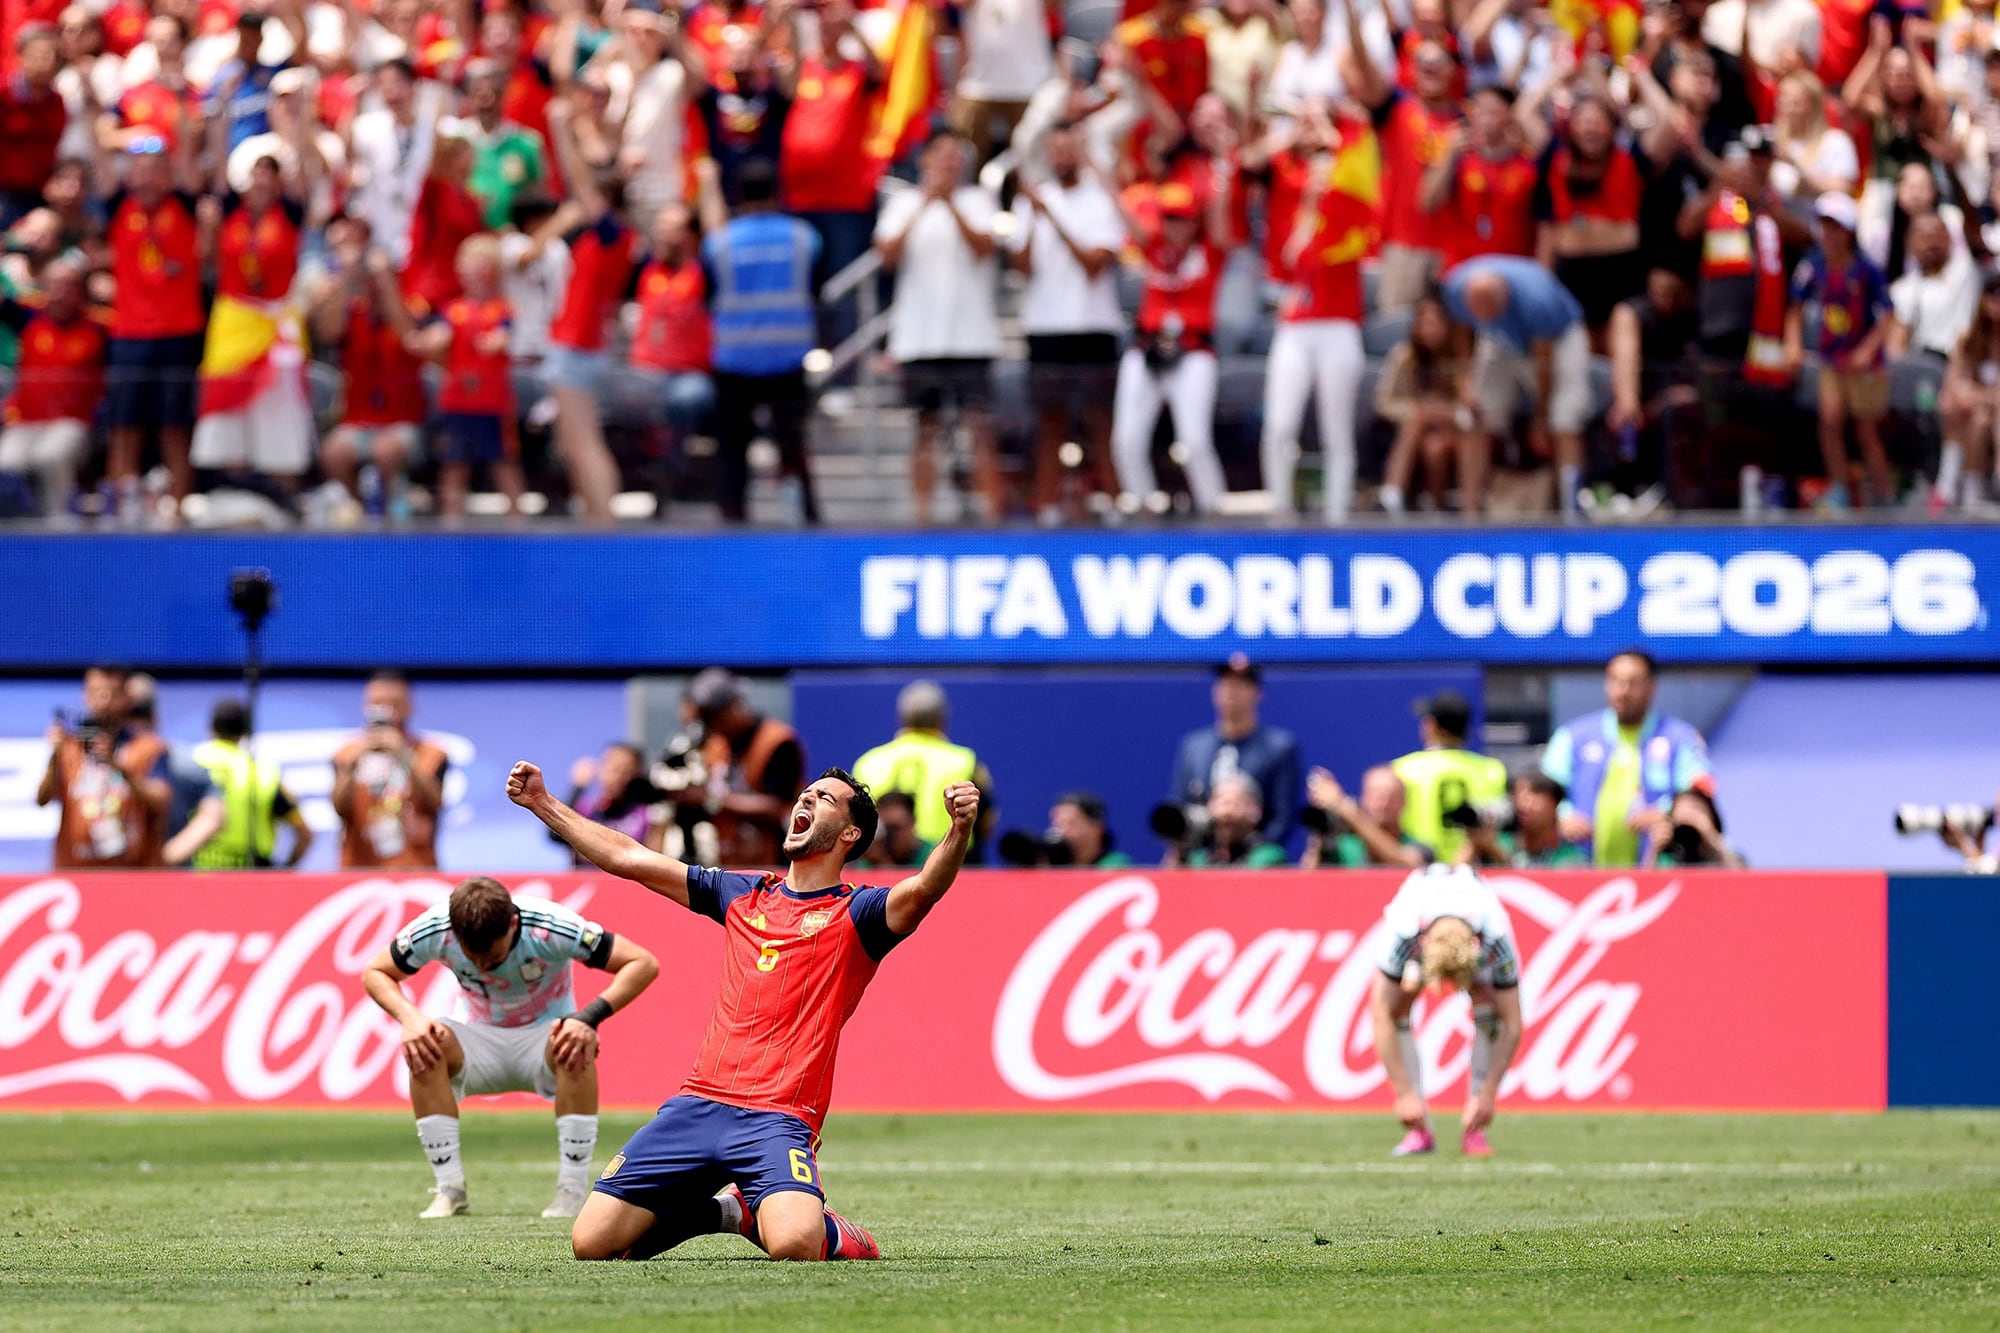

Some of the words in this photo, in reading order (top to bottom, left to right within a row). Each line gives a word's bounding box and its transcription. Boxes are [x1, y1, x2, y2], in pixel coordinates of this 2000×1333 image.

[862, 554, 1068, 639] FIFA
[1074, 553, 1424, 639] WORLD
[1433, 552, 1628, 639] CUP
[1638, 549, 1980, 638] 2026
[756, 939, 785, 972] 6
[991, 875, 1682, 1102] Coca-Cola
[788, 1148, 813, 1184] 6
